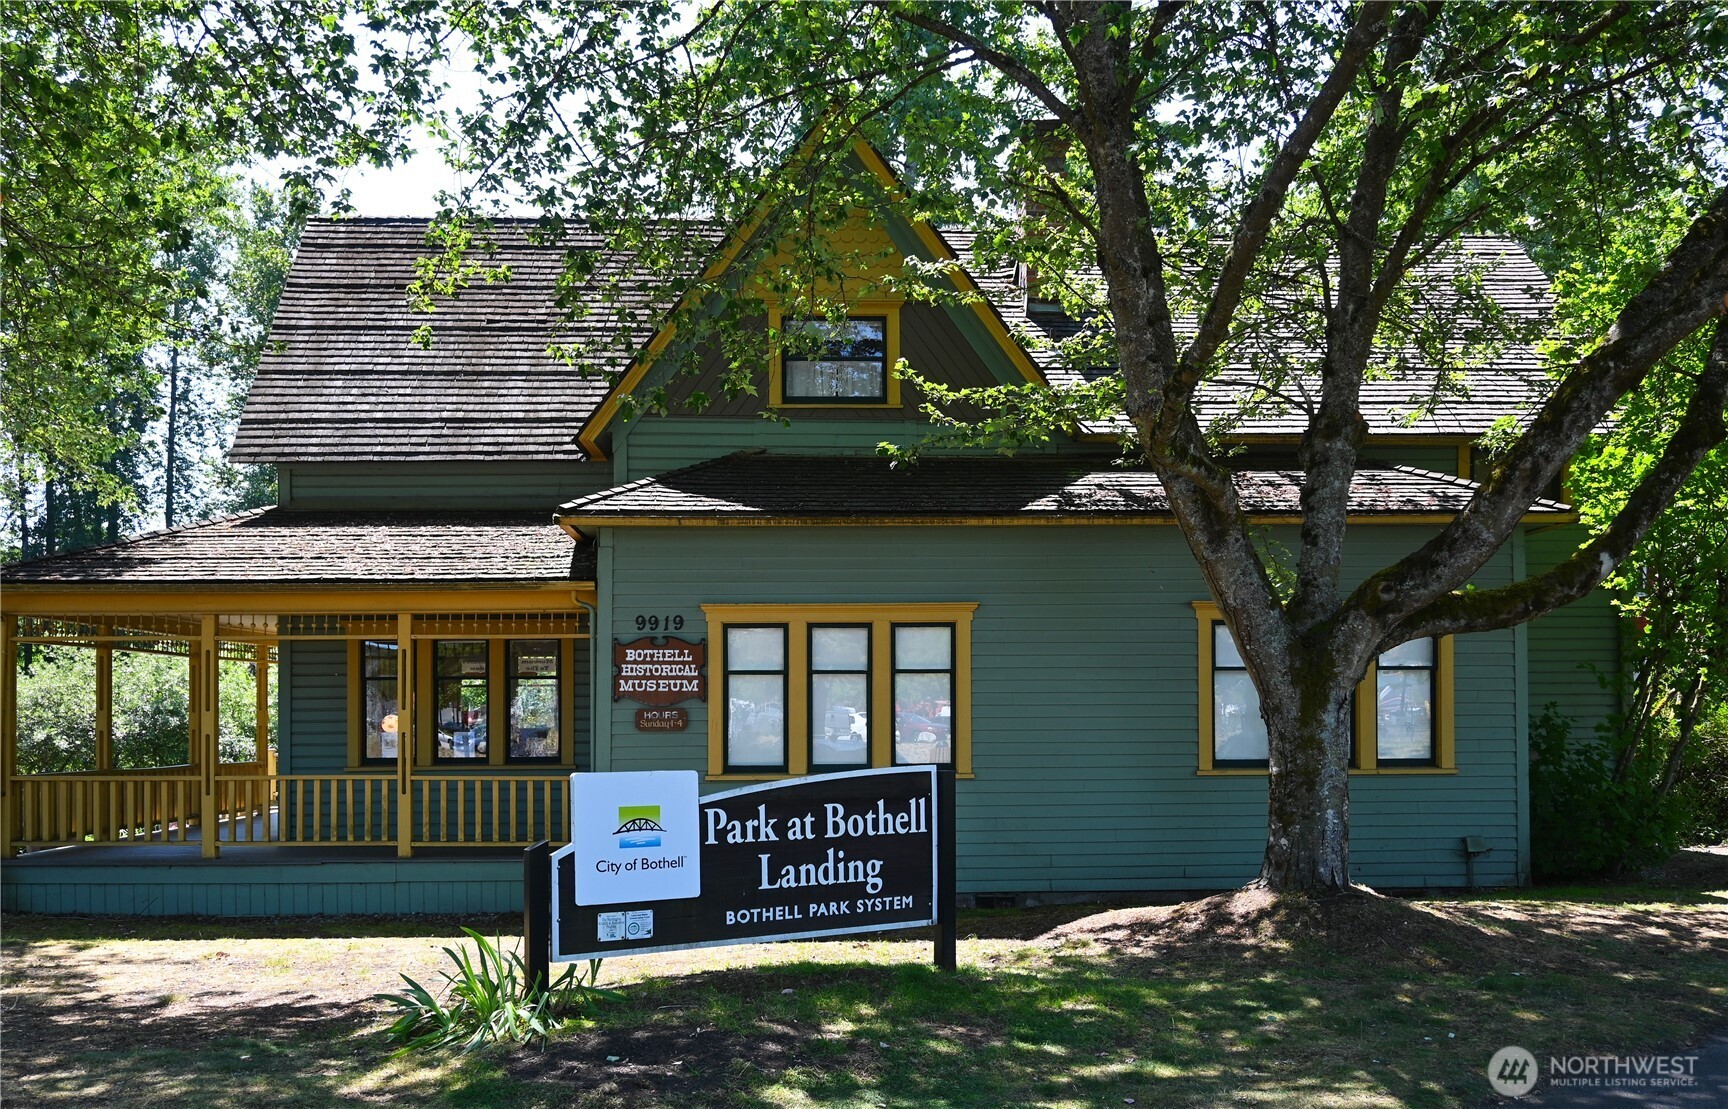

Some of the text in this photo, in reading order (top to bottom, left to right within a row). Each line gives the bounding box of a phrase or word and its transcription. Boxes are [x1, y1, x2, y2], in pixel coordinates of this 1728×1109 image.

[636, 615, 685, 631] 9919
[626, 649, 692, 661] BOTHELL
[621, 664, 698, 676] HISTORICAL
[619, 680, 699, 691] MUSEUM
[643, 711, 679, 719] HOURS
[704, 797, 928, 845] Park at Bothell
[596, 860, 622, 875] City
[625, 858, 638, 871] of
[758, 847, 884, 894] Landing
[726, 895, 914, 925] BOTHELL PARK SYSTEM
